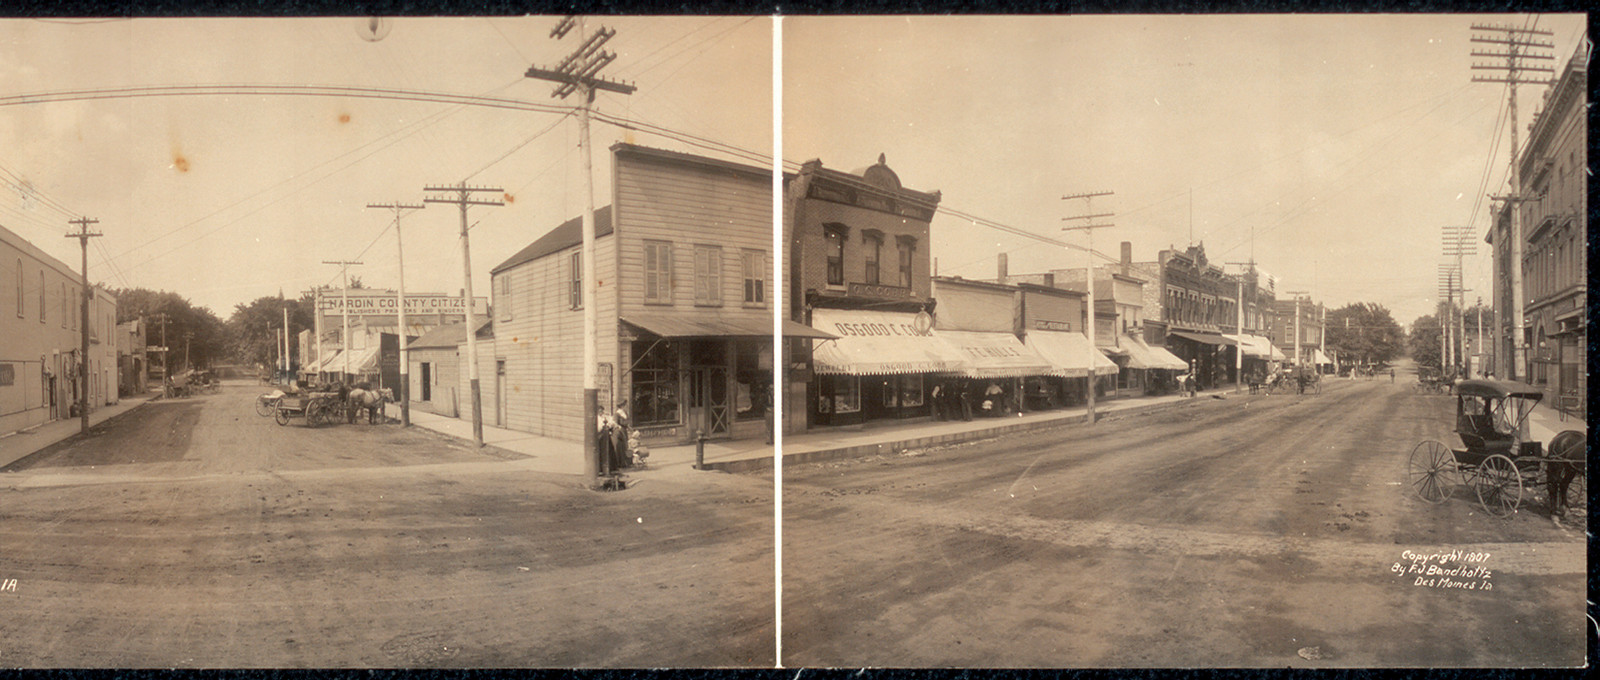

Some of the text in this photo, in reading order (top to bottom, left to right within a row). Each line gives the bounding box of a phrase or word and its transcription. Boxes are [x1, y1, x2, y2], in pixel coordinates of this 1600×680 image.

[330, 299, 374, 309] HARDIN
[834, 322, 891, 336] OSGOOD
[880, 362, 913, 372] OSGOOD
